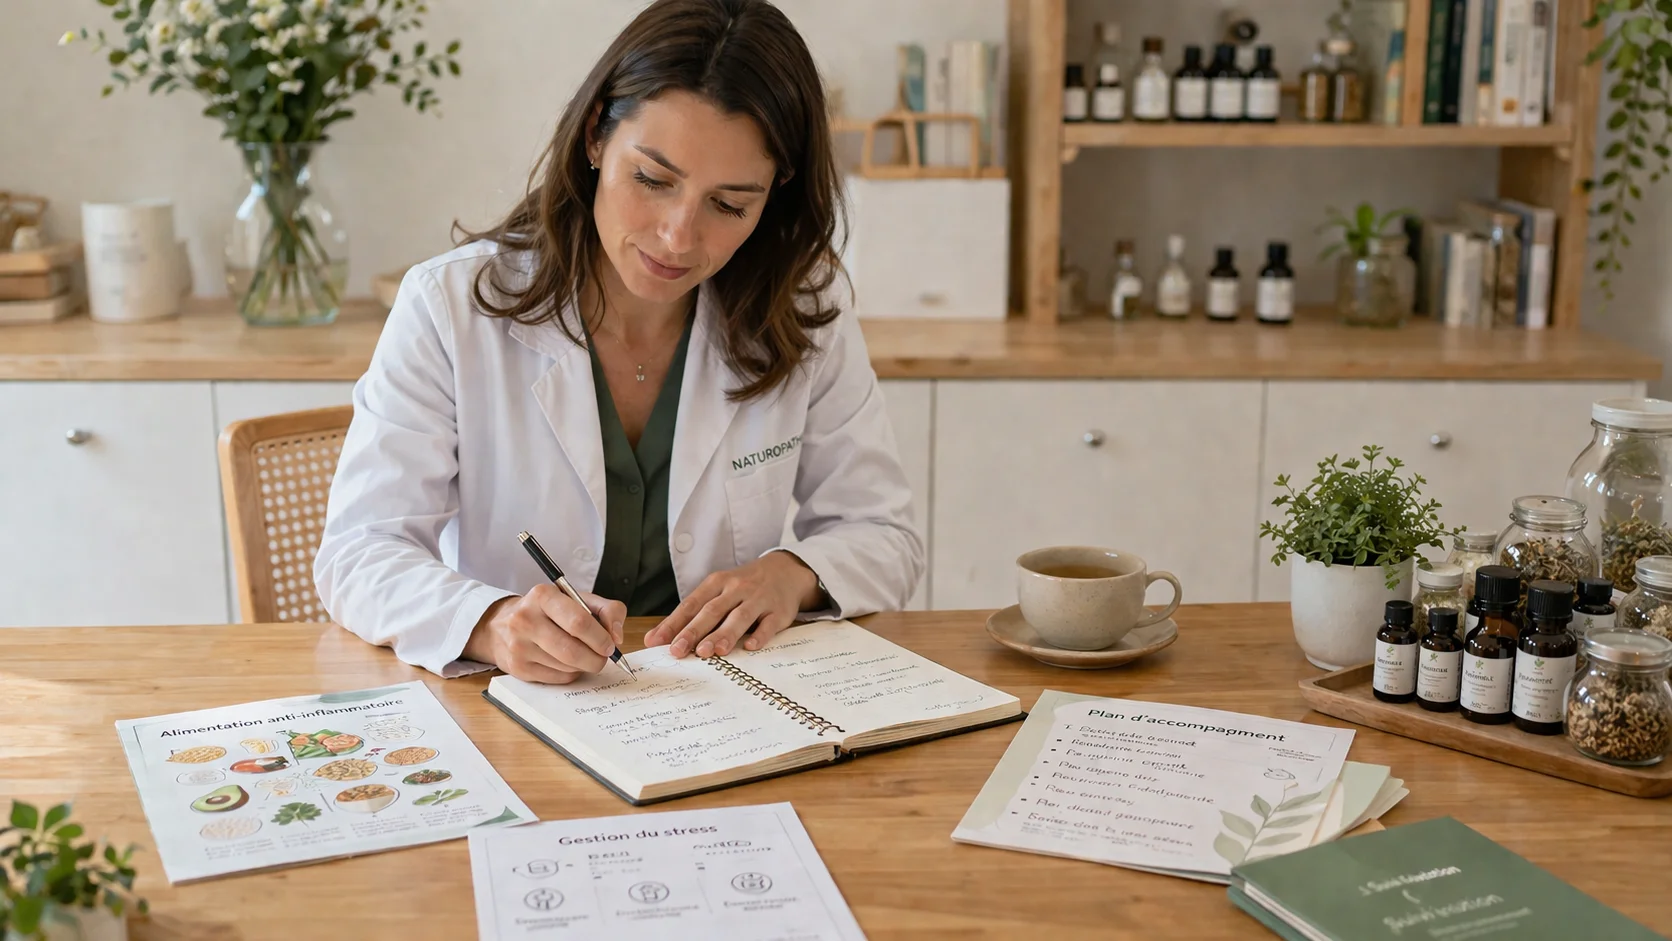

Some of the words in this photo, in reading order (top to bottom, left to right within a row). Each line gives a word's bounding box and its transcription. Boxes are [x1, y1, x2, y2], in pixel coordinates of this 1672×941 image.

[160, 717, 263, 738] Alimentation
[267, 698, 404, 724] anti-inflammatoire
[1087, 709, 1125, 720] Plan
[1130, 714, 1286, 743] d'accompagment
[558, 832, 631, 846] Gestion
[635, 828, 660, 840] du
[663, 824, 719, 837] stress
